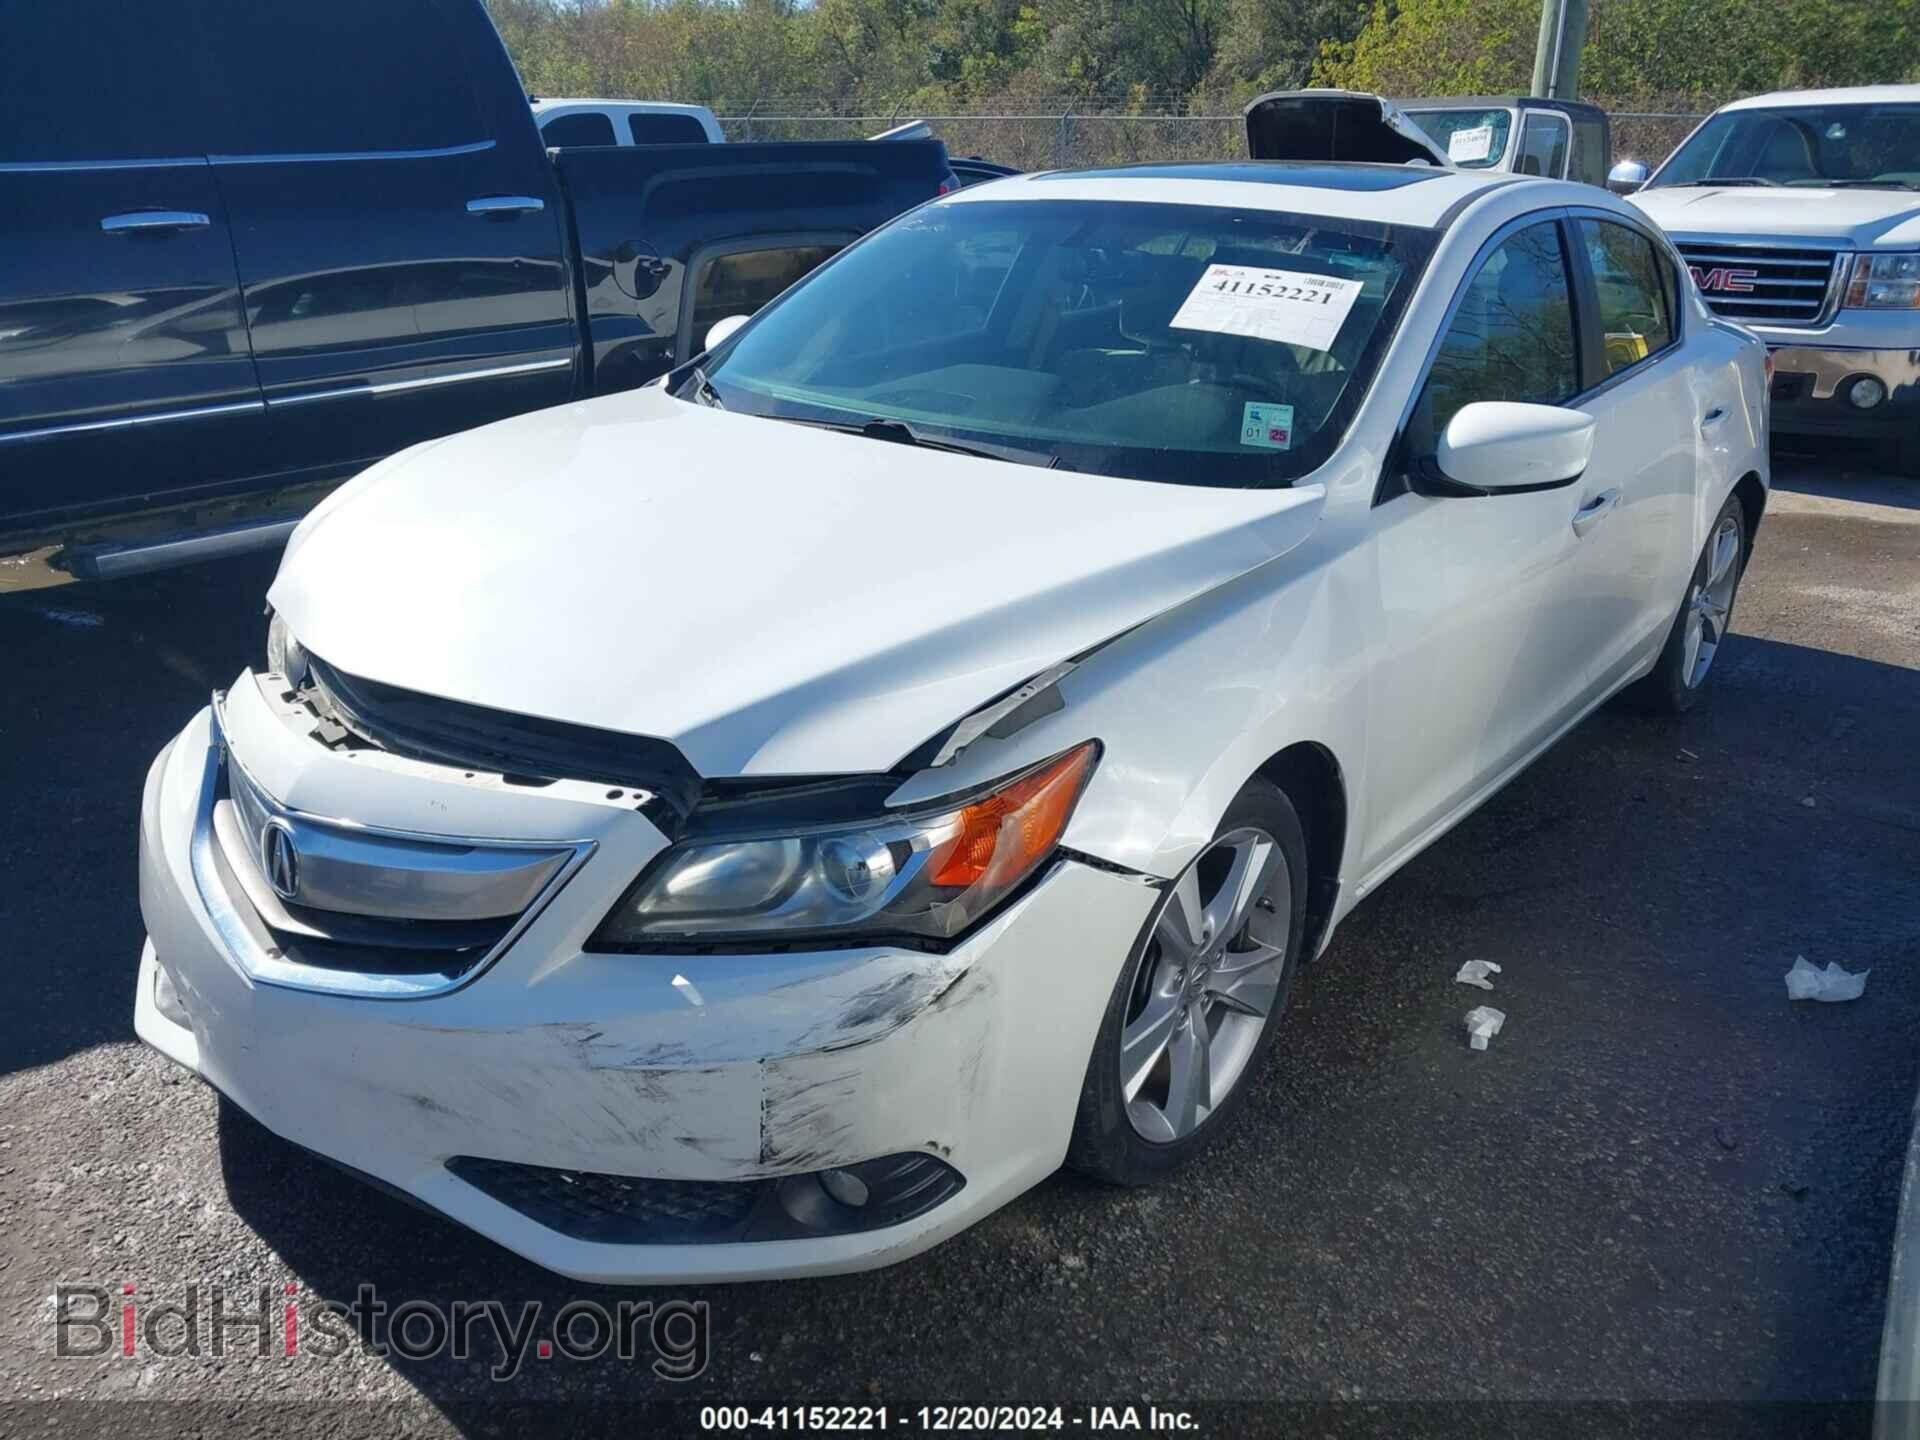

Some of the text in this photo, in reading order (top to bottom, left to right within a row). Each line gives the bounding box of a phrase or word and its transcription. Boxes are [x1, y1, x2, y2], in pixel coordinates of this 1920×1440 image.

[1688, 265, 1758, 292] MC
[1213, 279, 1332, 305] 41152221
[1246, 427, 1289, 442] 01 25
